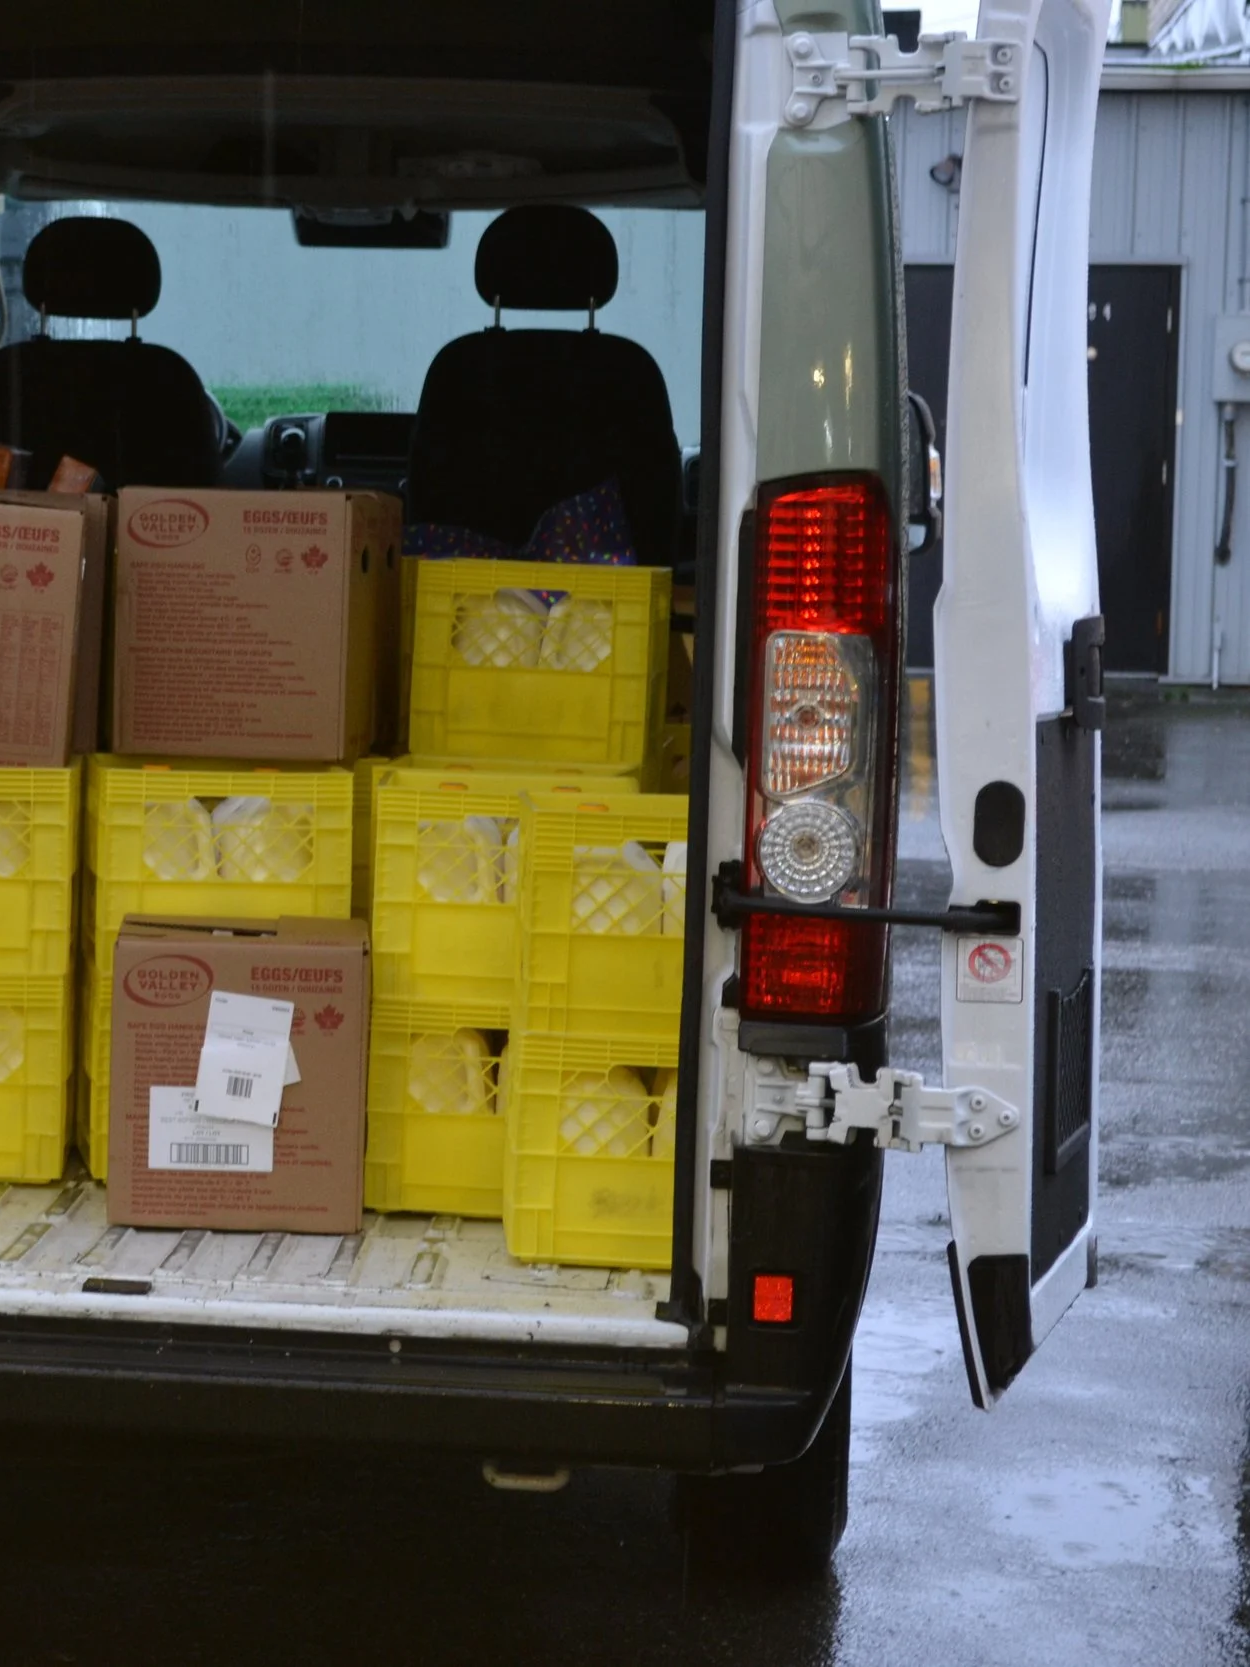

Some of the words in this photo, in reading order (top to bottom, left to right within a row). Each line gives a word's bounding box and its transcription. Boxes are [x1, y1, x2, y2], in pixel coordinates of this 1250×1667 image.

[139, 513, 197, 523] GOLDEN
[243, 510, 328, 525] EGGS/ŒUFS
[141, 523, 195, 533] VALLEY
[137, 969, 199, 980] GOLDEN
[251, 966, 343, 983] EGGS/ŒUFS
[139, 980, 198, 991] VALLEY
